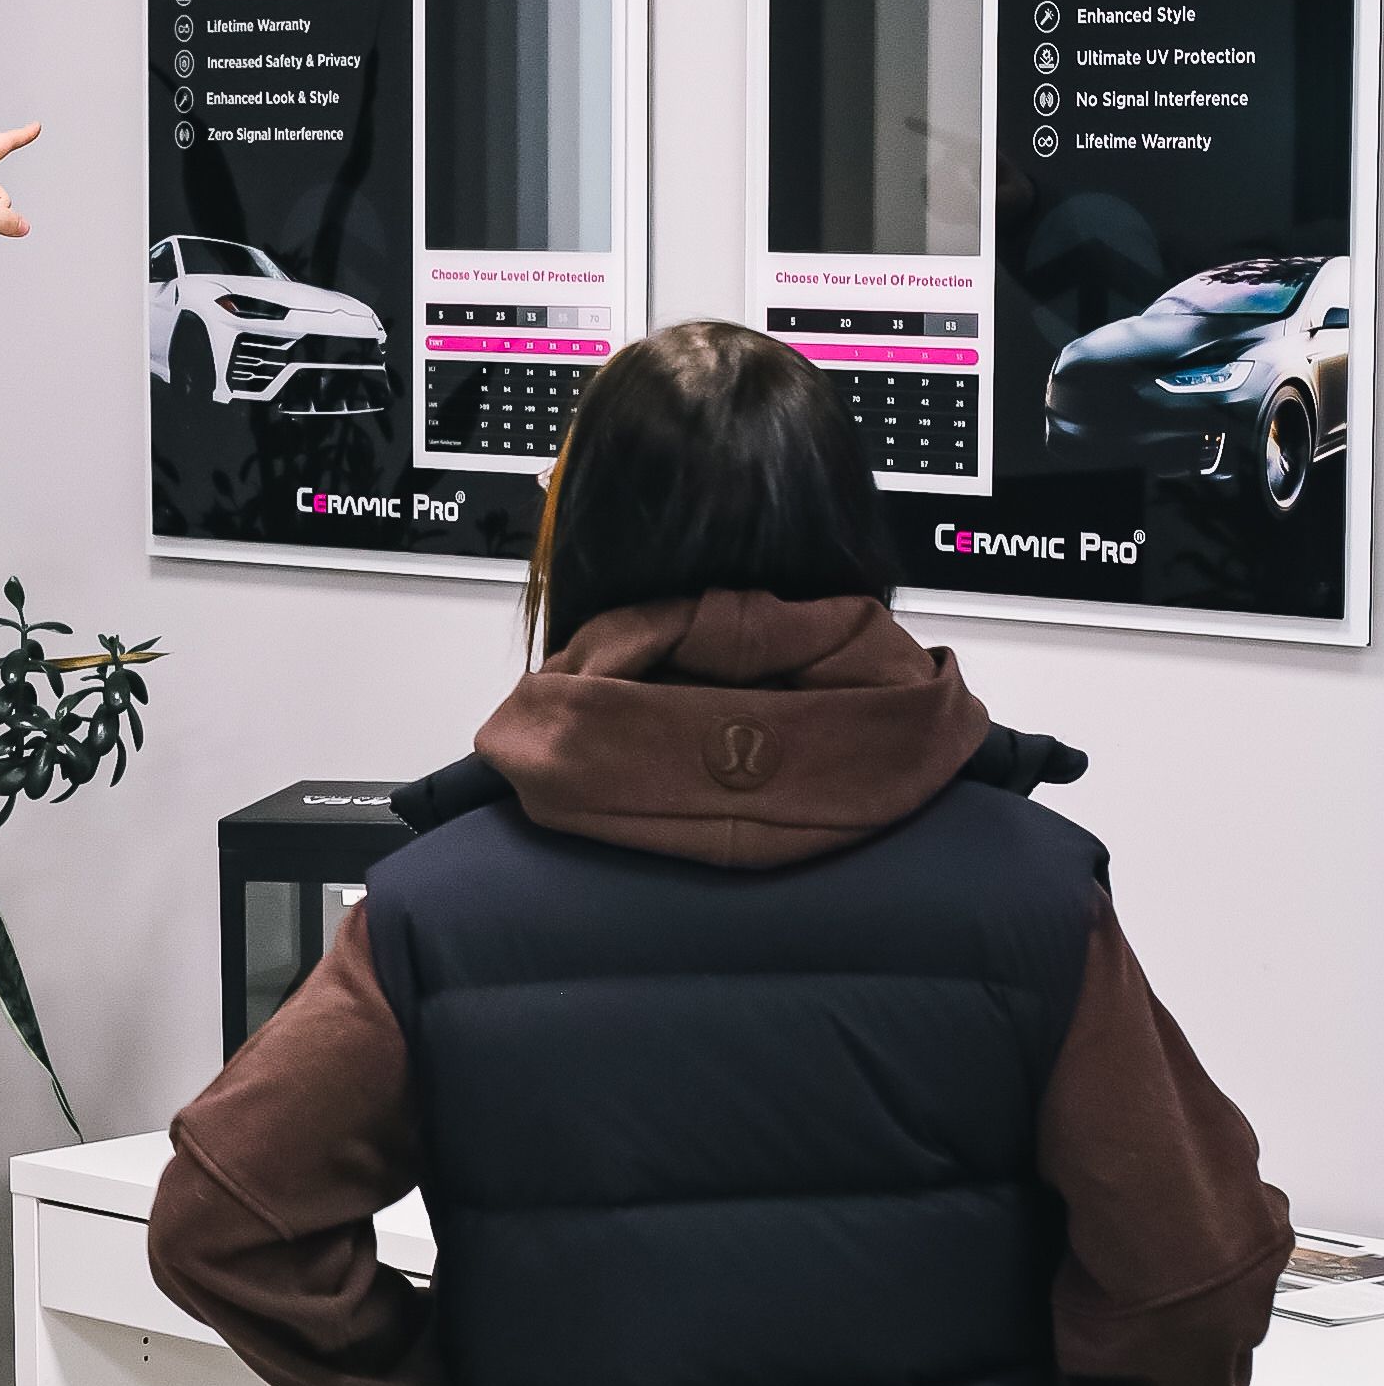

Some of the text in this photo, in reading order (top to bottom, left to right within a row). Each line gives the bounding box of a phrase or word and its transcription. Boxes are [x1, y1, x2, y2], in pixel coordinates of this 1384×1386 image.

[1078, 6, 1195, 24] Enhanced Style
[207, 19, 310, 33] Lifetime Warranty
[208, 53, 360, 69] Increased Safety & Privacy
[1077, 48, 1255, 65] Ultimate UV Protection
[207, 90, 339, 106] Enhanced Look & Style
[1077, 90, 1248, 109] No Signal Interference
[208, 127, 343, 143] Zero Signal Interference
[1077, 133, 1211, 151] Lifetime Warranty
[432, 269, 604, 282] Choose Your Level Of Protection
[776, 272, 972, 287] Choose Your Level Of Protection
[439, 311, 443, 319] 5
[496, 312, 505, 320] 25
[590, 315, 599, 323] 70
[791, 317, 795, 326] 5
[841, 319, 851, 327] 20
[893, 320, 903, 329] 35
